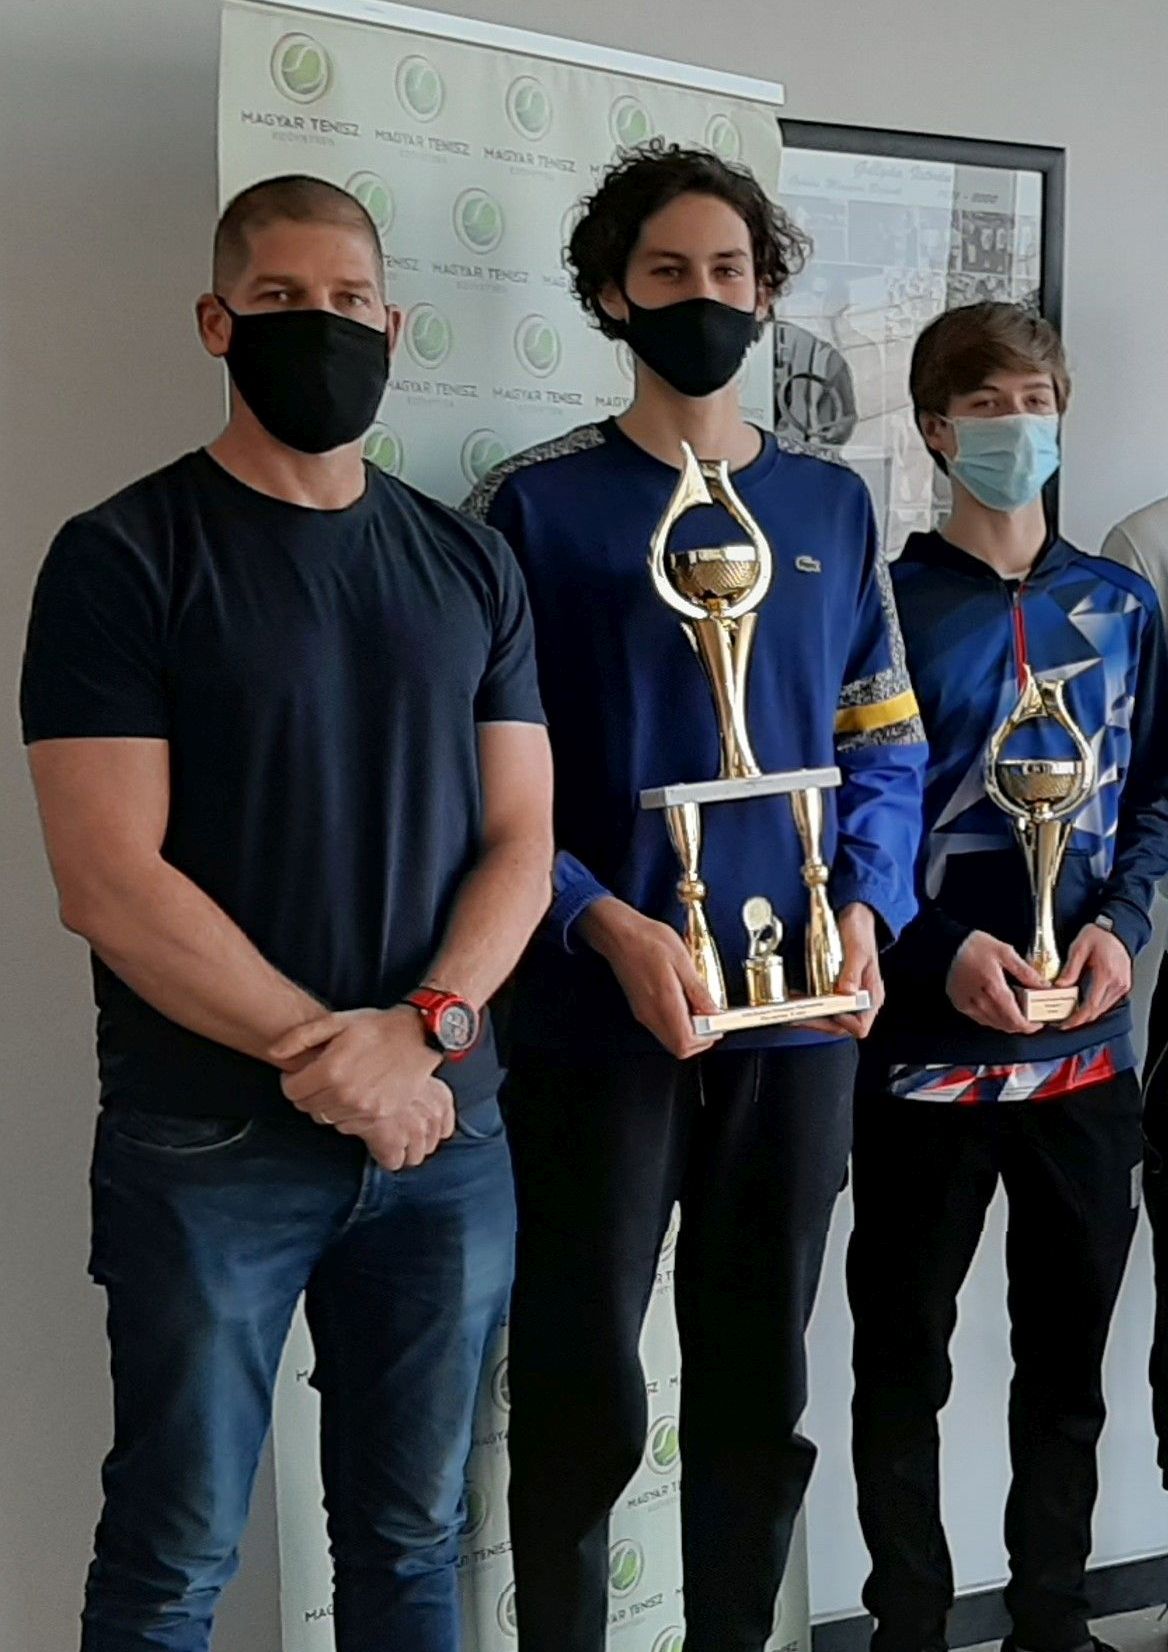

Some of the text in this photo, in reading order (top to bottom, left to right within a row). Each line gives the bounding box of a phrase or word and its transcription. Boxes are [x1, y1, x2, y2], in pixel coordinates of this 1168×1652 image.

[240, 109, 361, 137] MAGYAR TENISZ
[374, 129, 471, 156] MAGYAR TENISZ
[483, 147, 534, 165] MAGYAR
[538, 154, 577, 174] TENISZ
[432, 263, 529, 284] MAGYAR TENISZ
[435, 382, 480, 398] TENISZ
[492, 387, 583, 406] MAGYAR TENISZ
